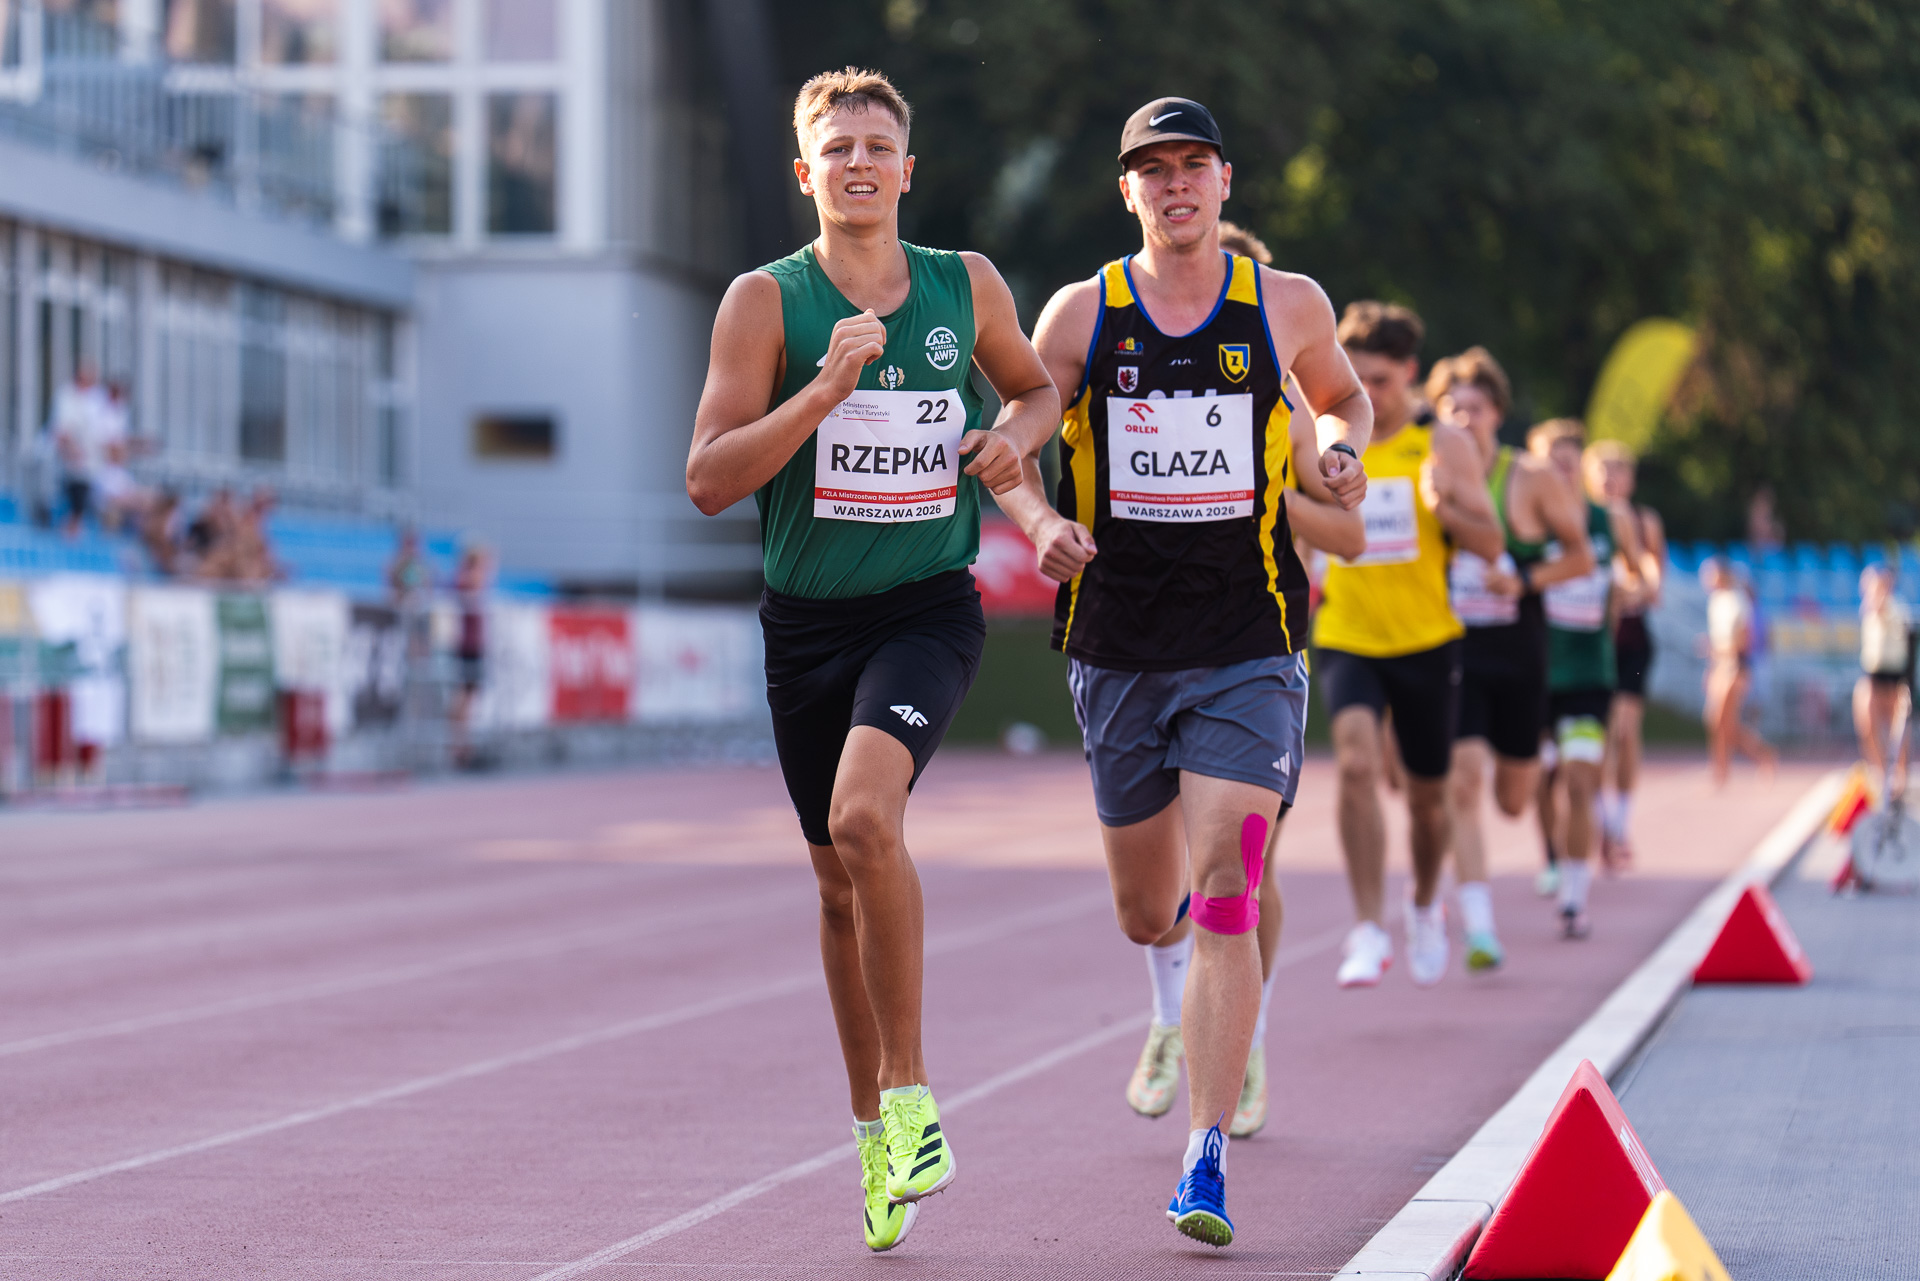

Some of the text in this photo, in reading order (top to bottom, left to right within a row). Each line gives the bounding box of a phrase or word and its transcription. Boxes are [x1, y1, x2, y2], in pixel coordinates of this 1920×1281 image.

[933, 333, 951, 344] AZS
[934, 350, 955, 361] AWF
[1231, 355, 1239, 366] Z
[916, 399, 949, 424] 22
[1206, 404, 1222, 427] 6
[1125, 424, 1158, 434] ORLEN
[831, 443, 947, 475] RZEPKA
[1130, 449, 1230, 477] GLAZA
[839, 492, 876, 500] Mistrzostwa
[904, 492, 937, 501] wielobojach
[937, 488, 951, 498] (U20)
[1131, 493, 1166, 502] Mistrzostwa
[1192, 494, 1229, 502] wielobojach
[1229, 491, 1247, 500] (U20)
[833, 504, 942, 518] WARSZAWA 2026
[1128, 505, 1236, 518] WARSZAWA 2026
[890, 705, 929, 727] 4F
